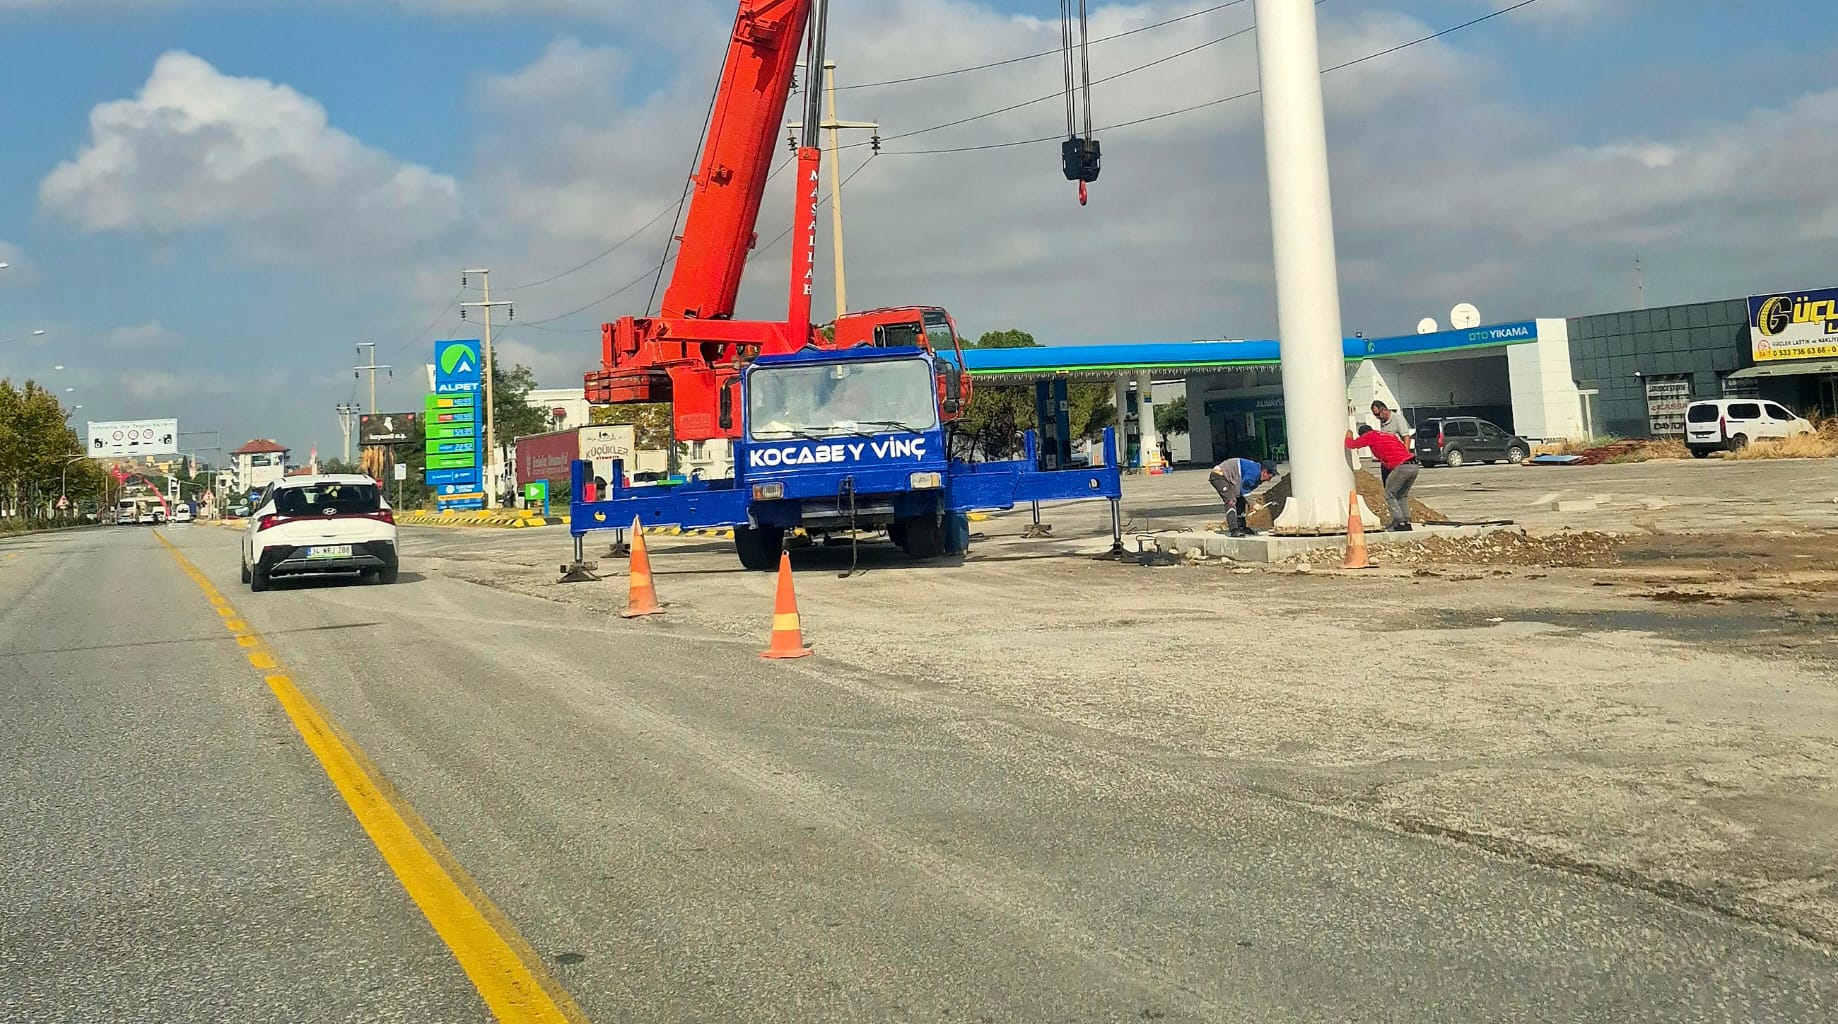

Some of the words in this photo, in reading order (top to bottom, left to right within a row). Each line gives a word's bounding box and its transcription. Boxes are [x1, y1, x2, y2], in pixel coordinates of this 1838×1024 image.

[1468, 331, 1488, 341] OTO
[1489, 326, 1529, 339] YIKAMA
[439, 382, 479, 392] ALPET
[585, 444, 629, 460] KÜÇÜKLER
[750, 443, 865, 467] KOCABEY
[870, 436, 926, 461] VİNÇ
